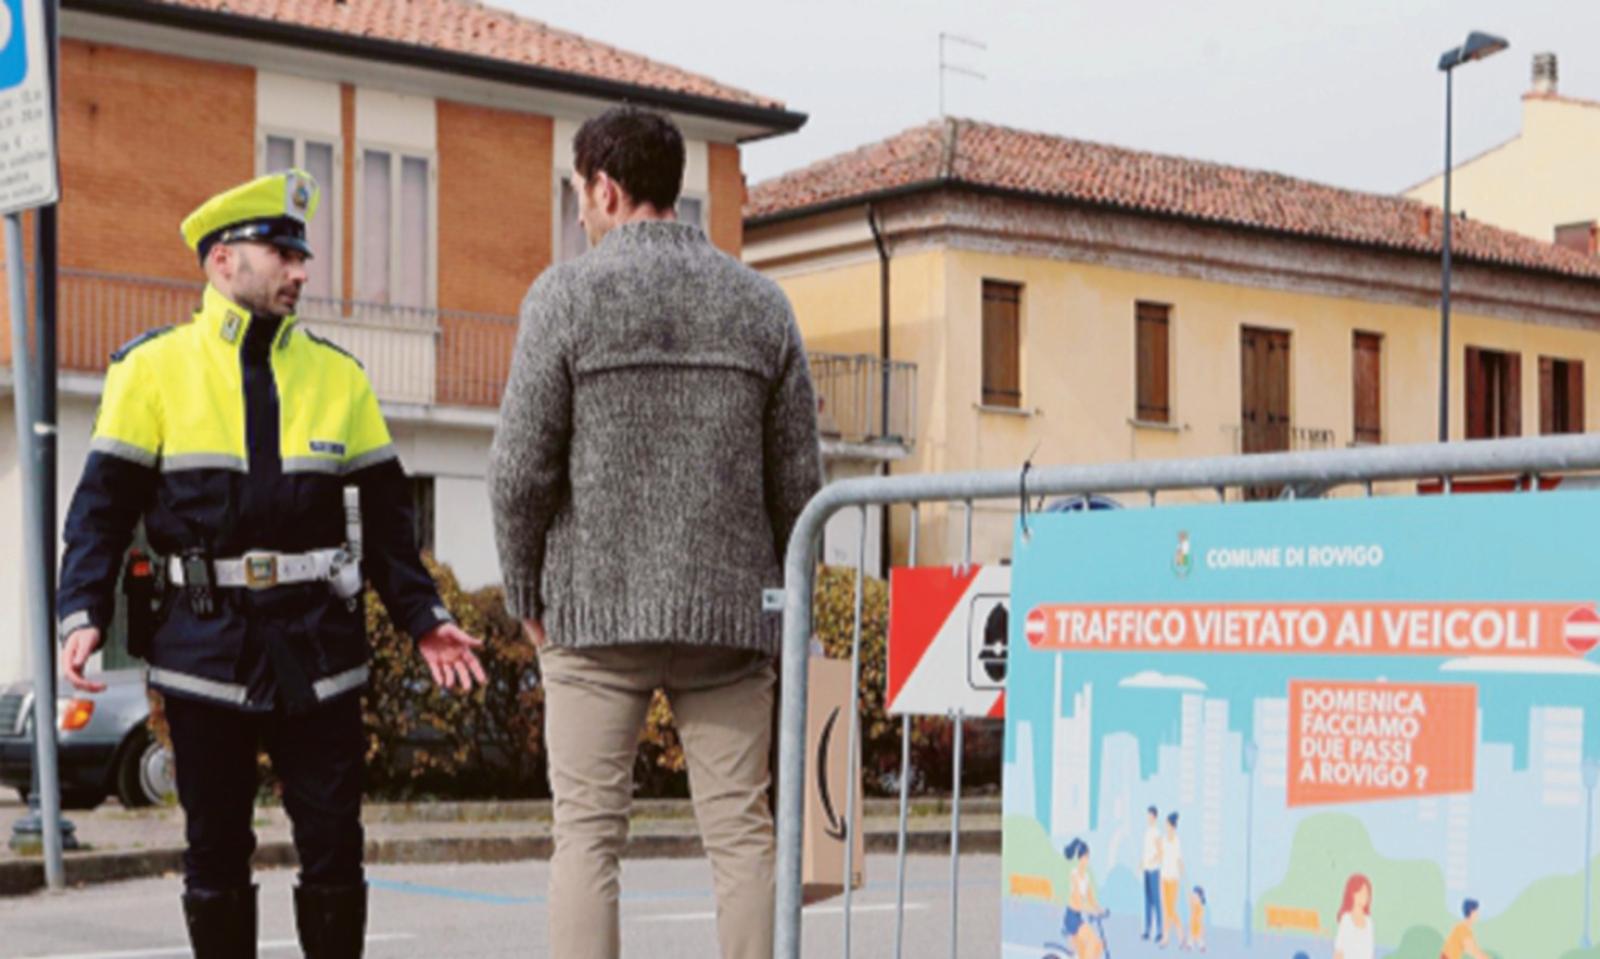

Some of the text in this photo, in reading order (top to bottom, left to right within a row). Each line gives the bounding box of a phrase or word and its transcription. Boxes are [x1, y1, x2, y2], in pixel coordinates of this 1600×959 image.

[1206, 544, 1384, 567] COMUNE DI ROVIGO
[1056, 609, 1539, 649] TRAFFICO VIETATO AI VEICOLI
[1302, 689, 1425, 713] DOMENICA
[1302, 713, 1418, 737] FACCIAMO
[1301, 737, 1411, 762] DUE PASSI
[1300, 761, 1427, 787] A ROVIGO ?
